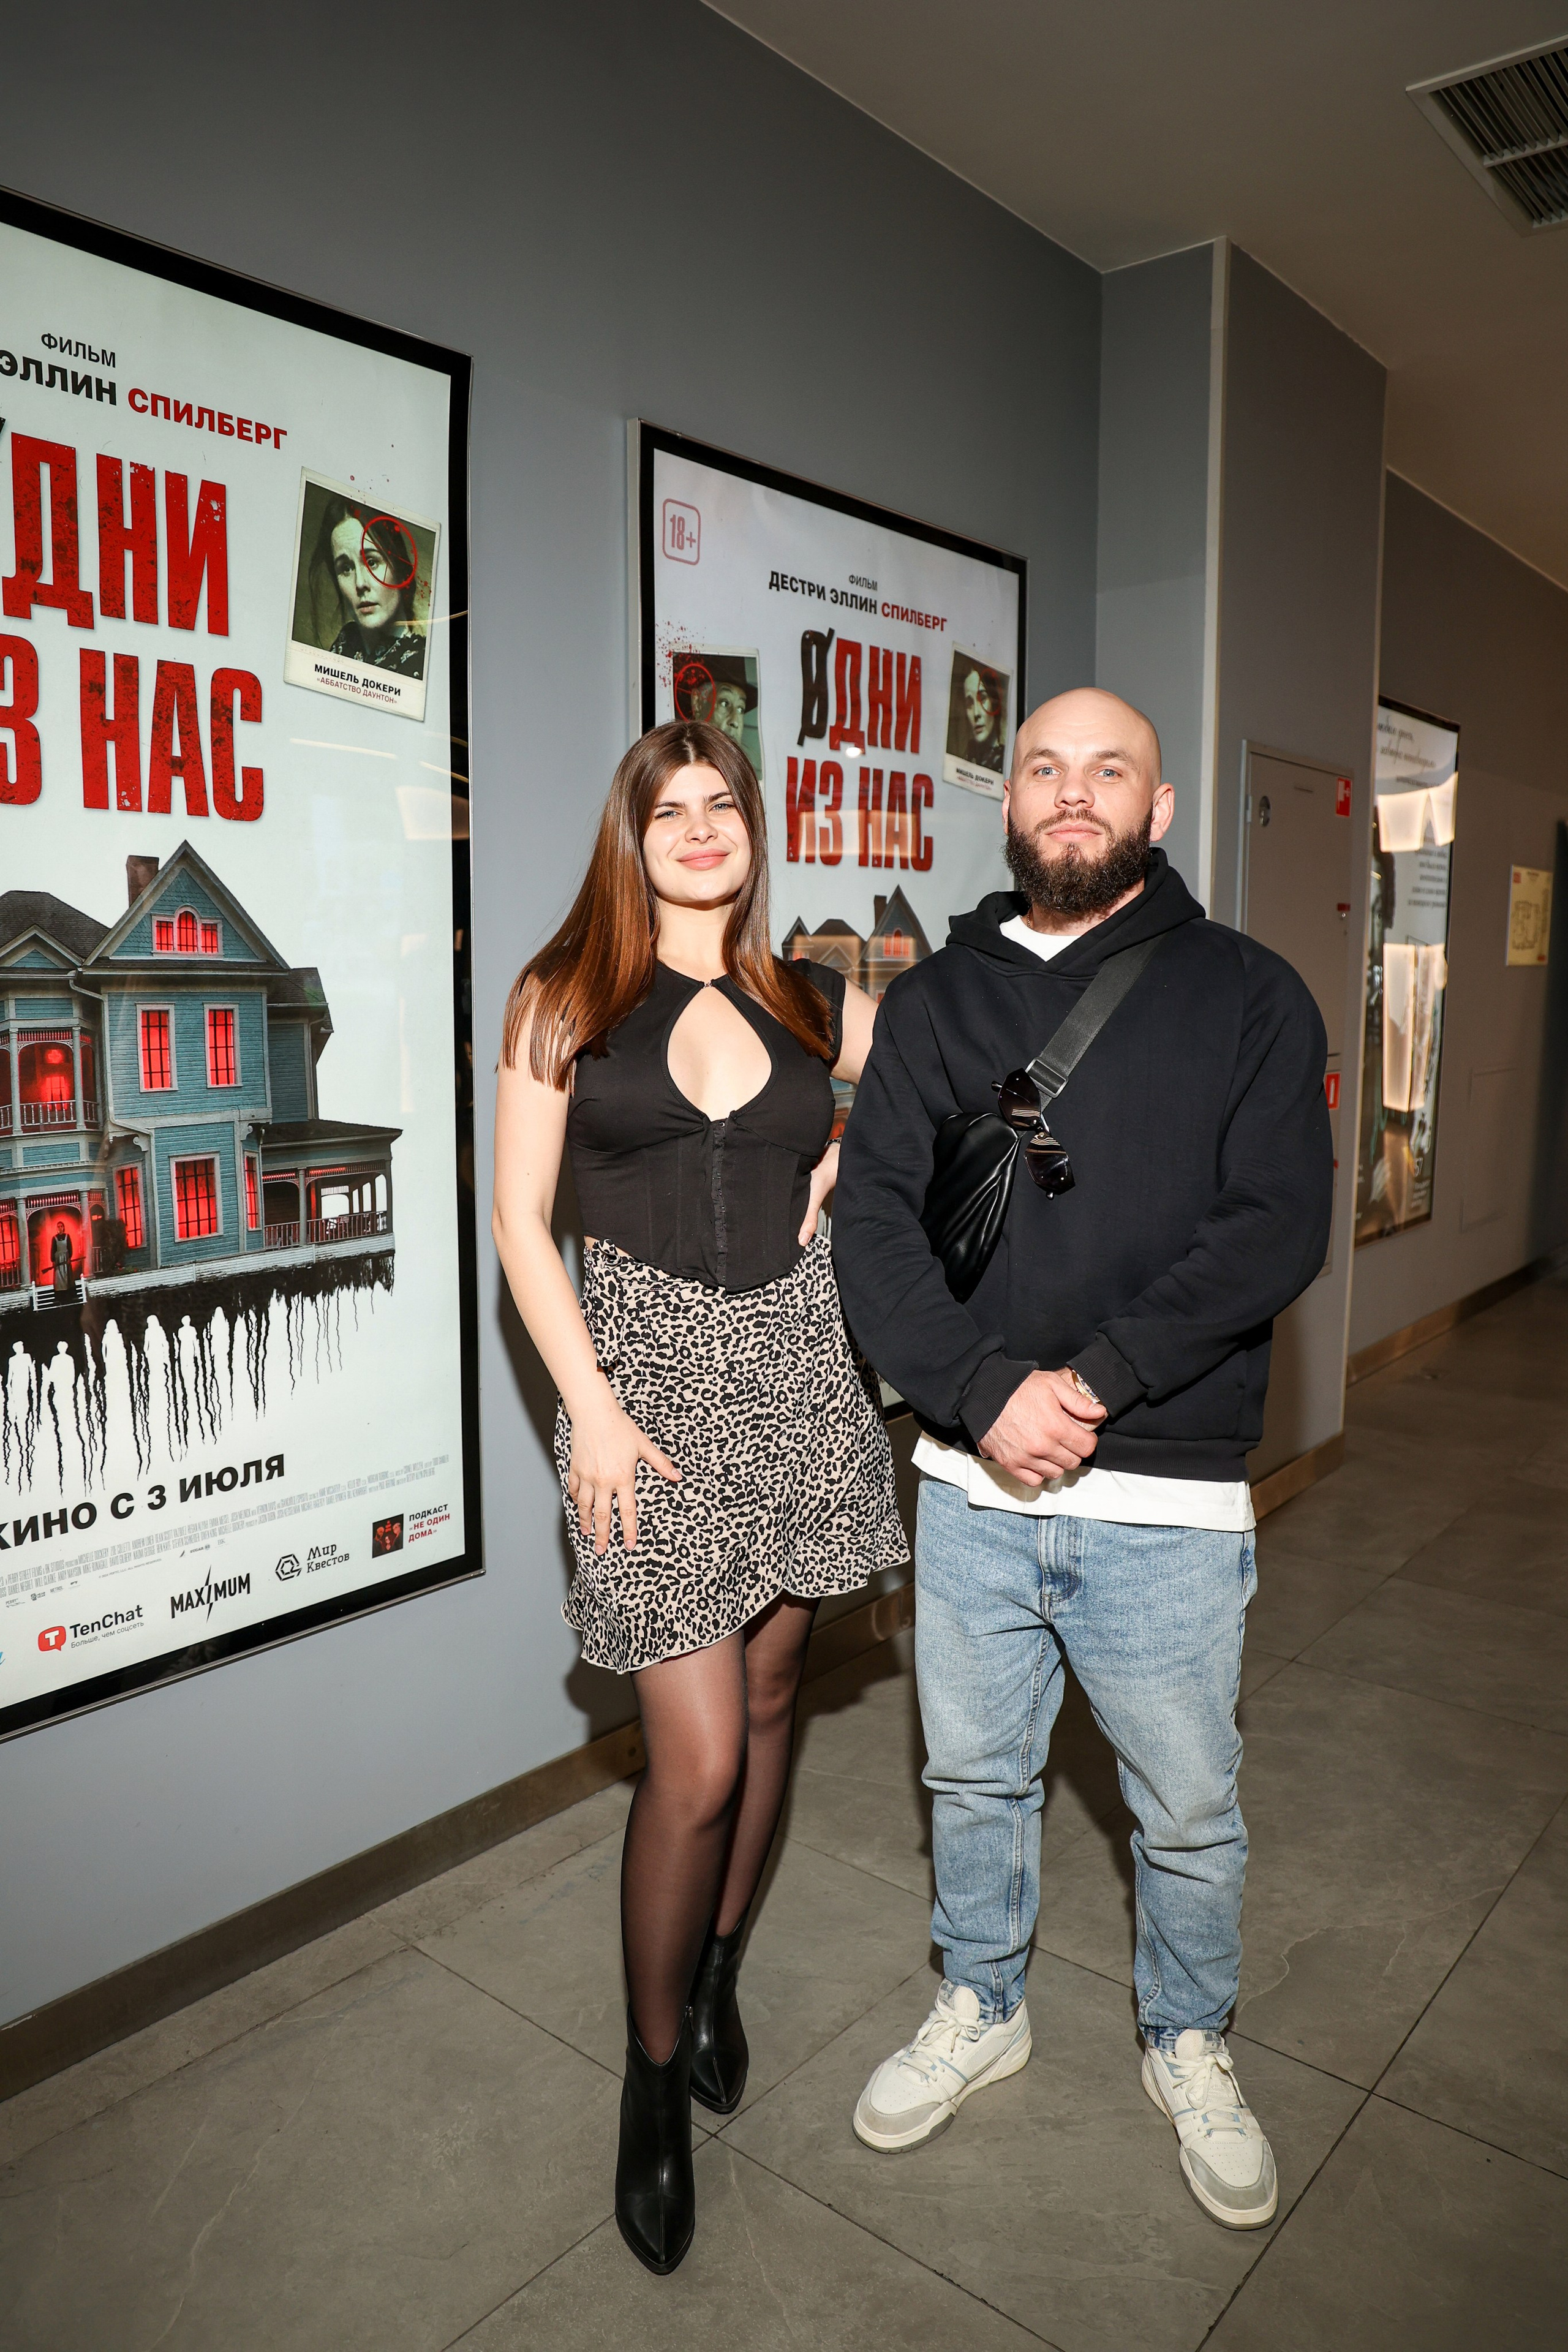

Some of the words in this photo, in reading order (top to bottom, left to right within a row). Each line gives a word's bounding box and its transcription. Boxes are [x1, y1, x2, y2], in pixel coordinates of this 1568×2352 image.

[41, 333, 116, 368] ФИЛЬМ
[0, 349, 117, 405] ЭЛЛИН
[127, 388, 287, 450] СПИЛБЕРГ
[669, 514, 696, 550] 18+
[848, 574, 878, 591] ФИЛЬМ
[769, 570, 826, 601] ДЕСТРИ
[829, 588, 877, 614] ЭЛЛИН
[881, 601, 948, 631] СПИЛБЕРГ
[314, 663, 360, 684] МИШЕЛЬ
[361, 678, 401, 696] ДОКЕРИ
[317, 677, 361, 694] «АББАТСТВО
[362, 689, 398, 704] ДАУНТОН»
[79, 647, 263, 822] НАС
[956, 767, 974, 779] МИШЕЛЬ
[974, 774, 994, 786] ДОКЕРИ
[786, 756, 844, 866] ИЗ
[858, 766, 935, 872] НАС
[110, 1492, 135, 1520] С
[147, 1485, 167, 1510] 3
[179, 1453, 285, 1503] ИЮЛЯ
[409, 1503, 448, 1521] ПОДКАСТ
[409, 1521, 424, 1531] «НЕ
[426, 1513, 450, 1526] ОДИН
[409, 1529, 437, 1543] ДОМА»
[307, 1544, 337, 1561] Мир
[307, 1553, 350, 1574] Квестов
[69, 1604, 143, 1638] TenChat
[71, 1635, 100, 1648] Больше,
[101, 1630, 115, 1639] чем
[116, 1621, 144, 1634] соцсеть
